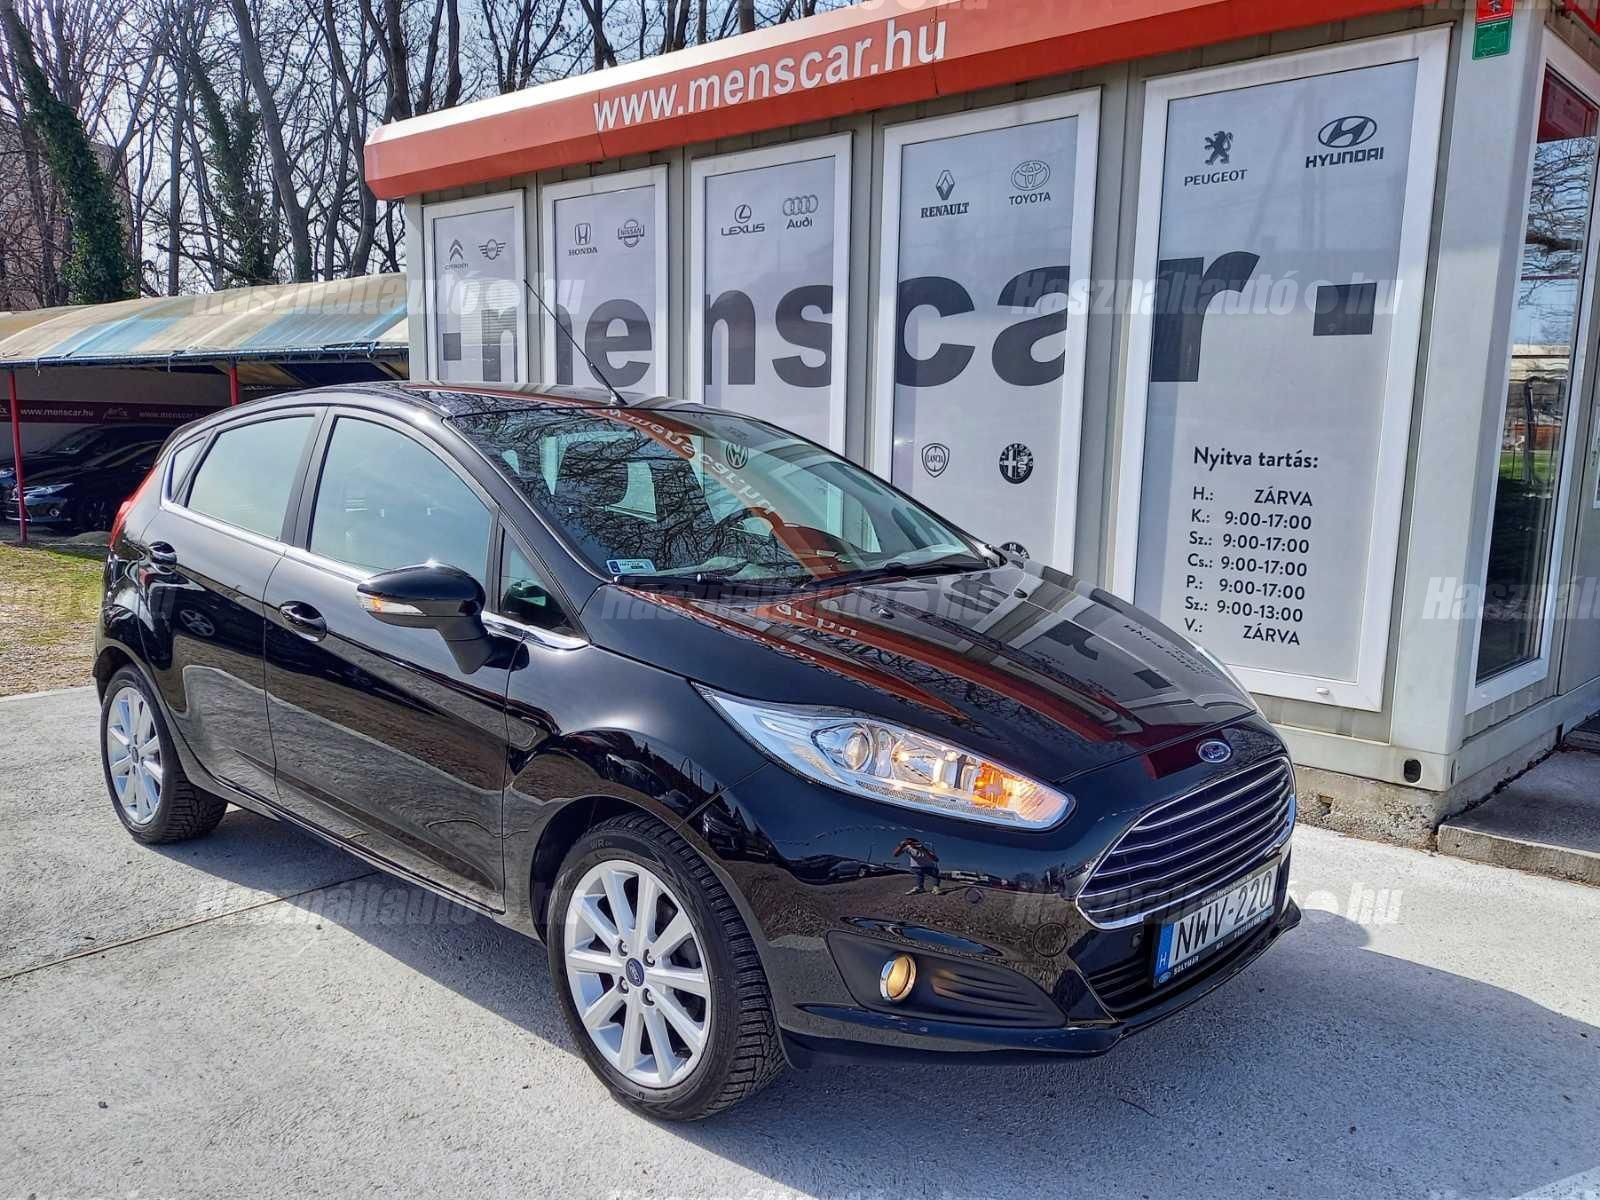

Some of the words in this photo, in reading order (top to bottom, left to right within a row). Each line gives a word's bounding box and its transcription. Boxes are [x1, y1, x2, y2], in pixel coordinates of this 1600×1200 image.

[593, 19, 947, 132] www.menscar.hu
[1305, 147, 1384, 168] HYUNDAI
[1184, 169, 1248, 187] PEUGEOT
[1009, 192, 1052, 205] TOYOTA
[920, 202, 970, 218] RENAULT
[620, 226, 642, 236] NISSAN
[721, 223, 765, 236] LEXUS
[786, 216, 813, 230] Audi
[568, 247, 598, 256] HONDA
[1193, 446, 1252, 471] Nyitva
[1258, 450, 1318, 468] tartás:
[1193, 486, 1214, 501] H.:
[1254, 485, 1313, 506] ZÁRVA
[1191, 508, 1210, 523] K.:
[1224, 510, 1312, 530] 9:00-17:00
[1189, 531, 1213, 546] Sz.:
[1222, 533, 1309, 554] 9:00-17:00
[1187, 553, 1213, 568] Cs.:
[1220, 556, 1307, 577] 9:00-17:00
[1186, 575, 1203, 590] P.:
[1218, 578, 1305, 600] 9:00-17:00
[1185, 596, 1208, 612] Sz.:
[1216, 600, 1303, 622] 9:00-13:00
[1184, 617, 1203, 633] V.:
[1242, 622, 1300, 646] ZÁRVA
[1175, 870, 1273, 961] NWV-220
[1159, 951, 1167, 969] H
